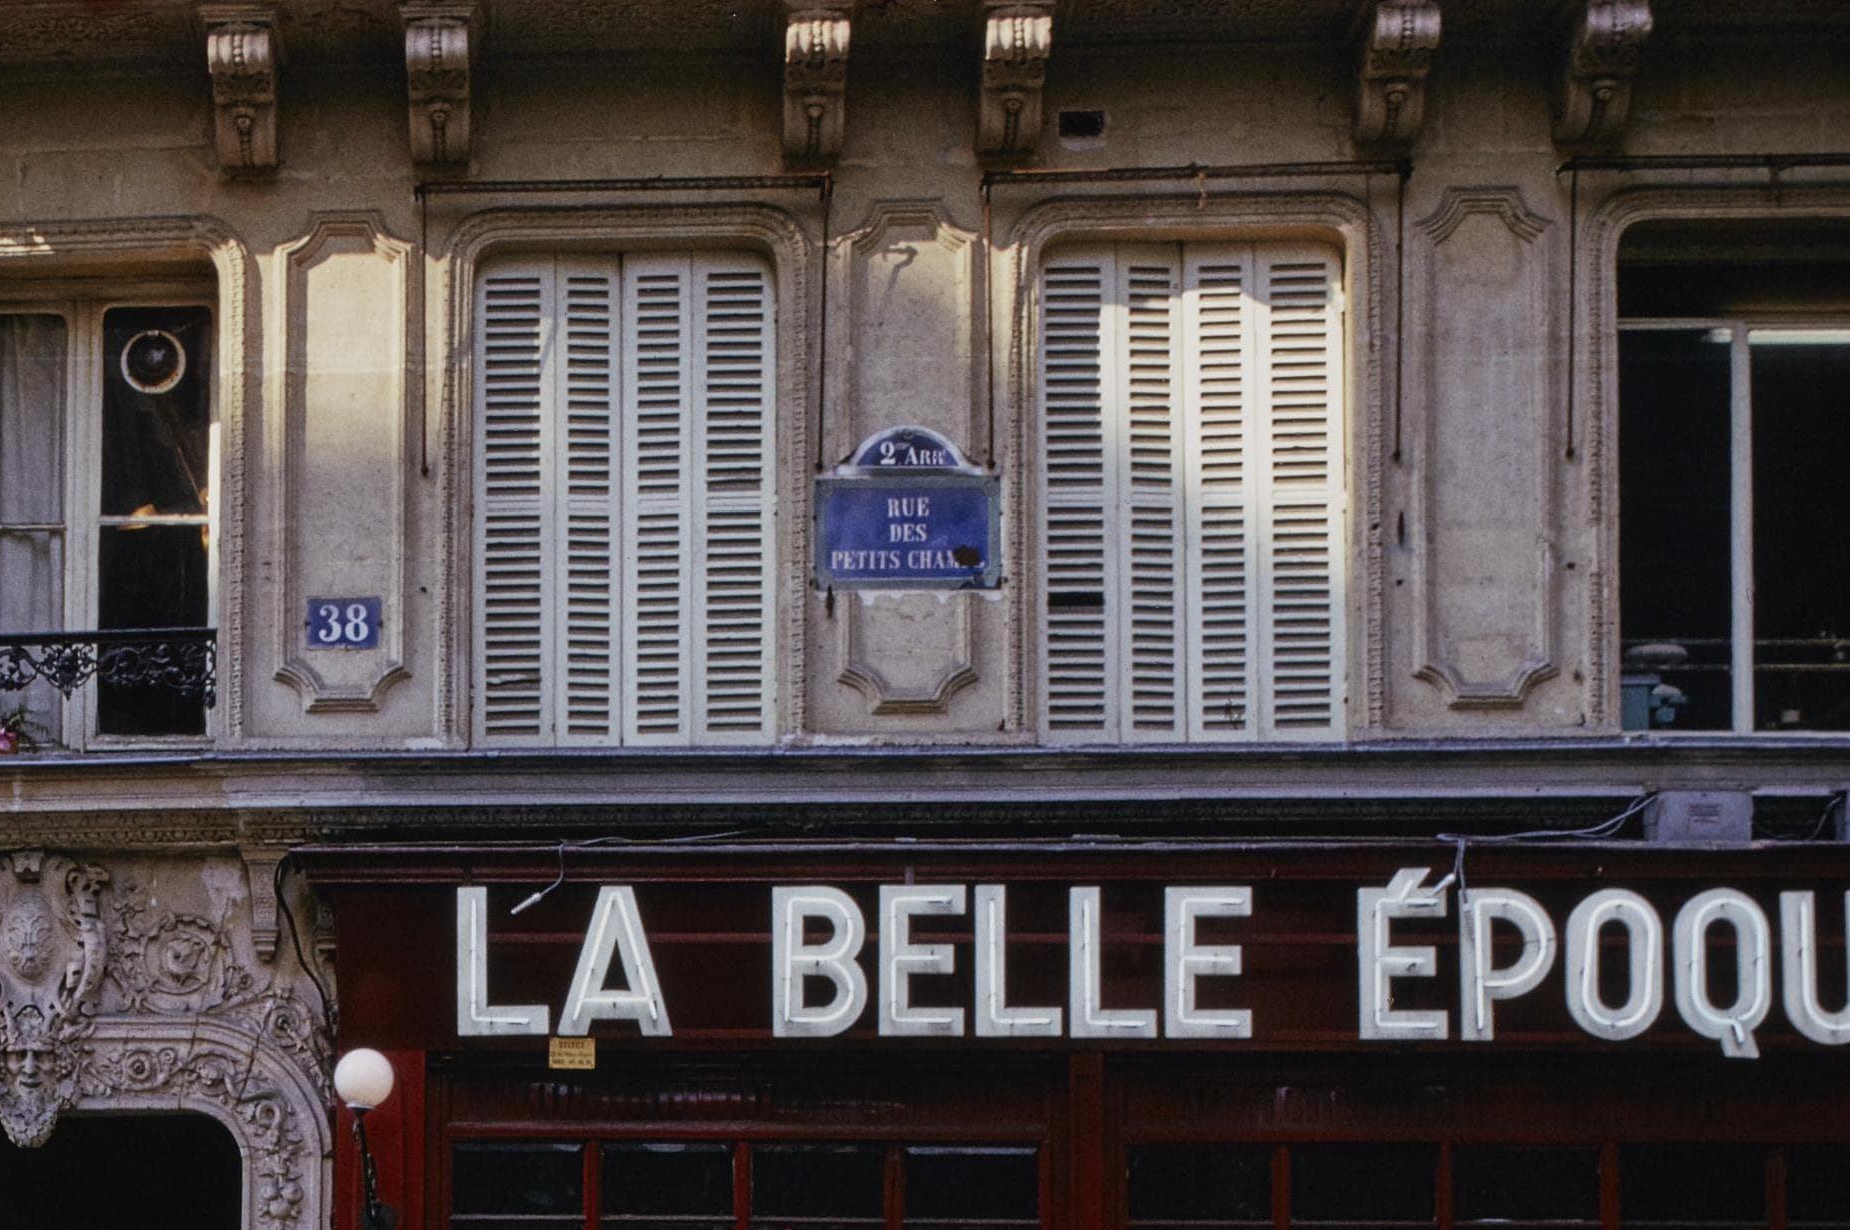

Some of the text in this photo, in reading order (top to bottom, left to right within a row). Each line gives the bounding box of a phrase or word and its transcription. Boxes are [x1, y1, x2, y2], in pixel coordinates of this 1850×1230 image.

[887, 497, 930, 518] RUE
[890, 524, 927, 542] DES
[831, 550, 901, 569] PETITS
[319, 604, 368, 642] 38
[456, 885, 673, 1037] LA
[771, 884, 1253, 1038] BELLE
